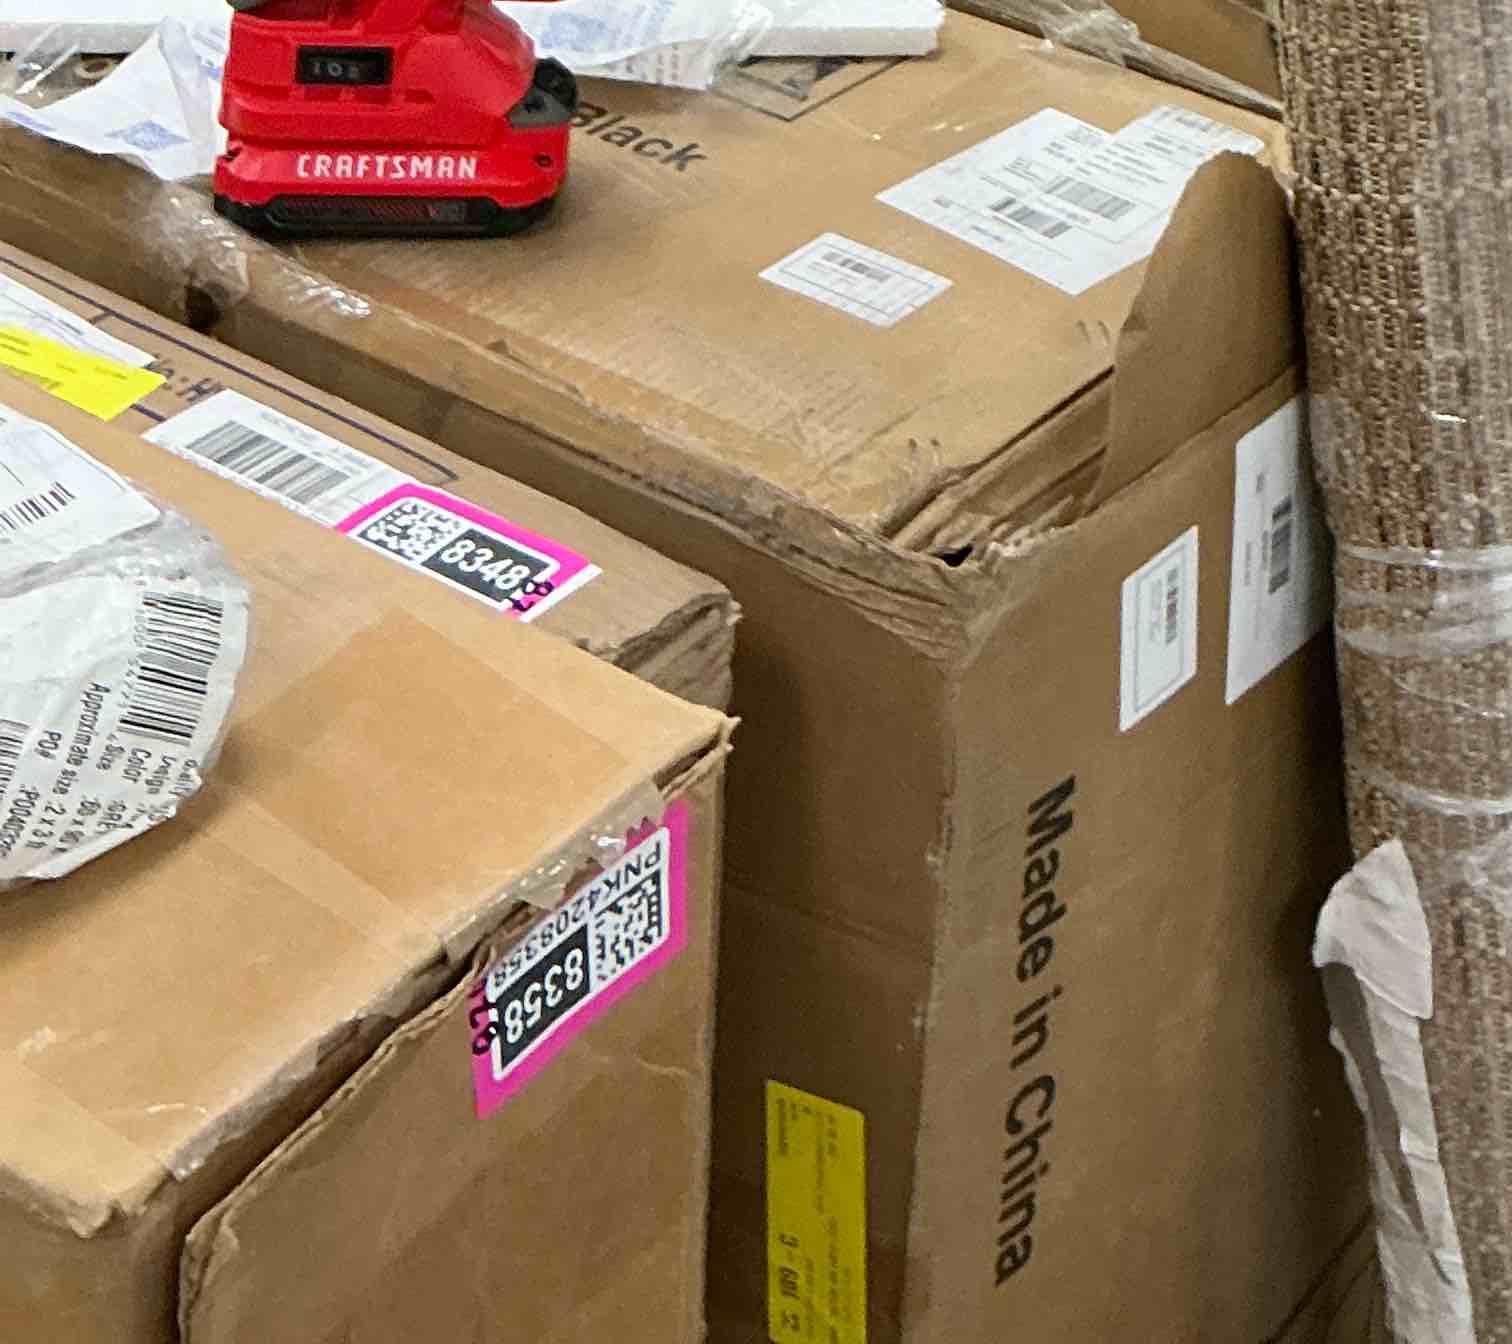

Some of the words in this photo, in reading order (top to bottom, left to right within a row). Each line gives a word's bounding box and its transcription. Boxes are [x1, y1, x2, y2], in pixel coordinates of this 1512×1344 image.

[296, 154, 478, 180] CRAFTSMAN
[440, 537, 532, 592] 8348
[66, 682, 111, 768] Approximate
[1015, 774, 1076, 983] Made
[503, 946, 585, 1045] 8358
[1009, 985, 1064, 1071] in
[995, 1074, 1057, 1289] China
